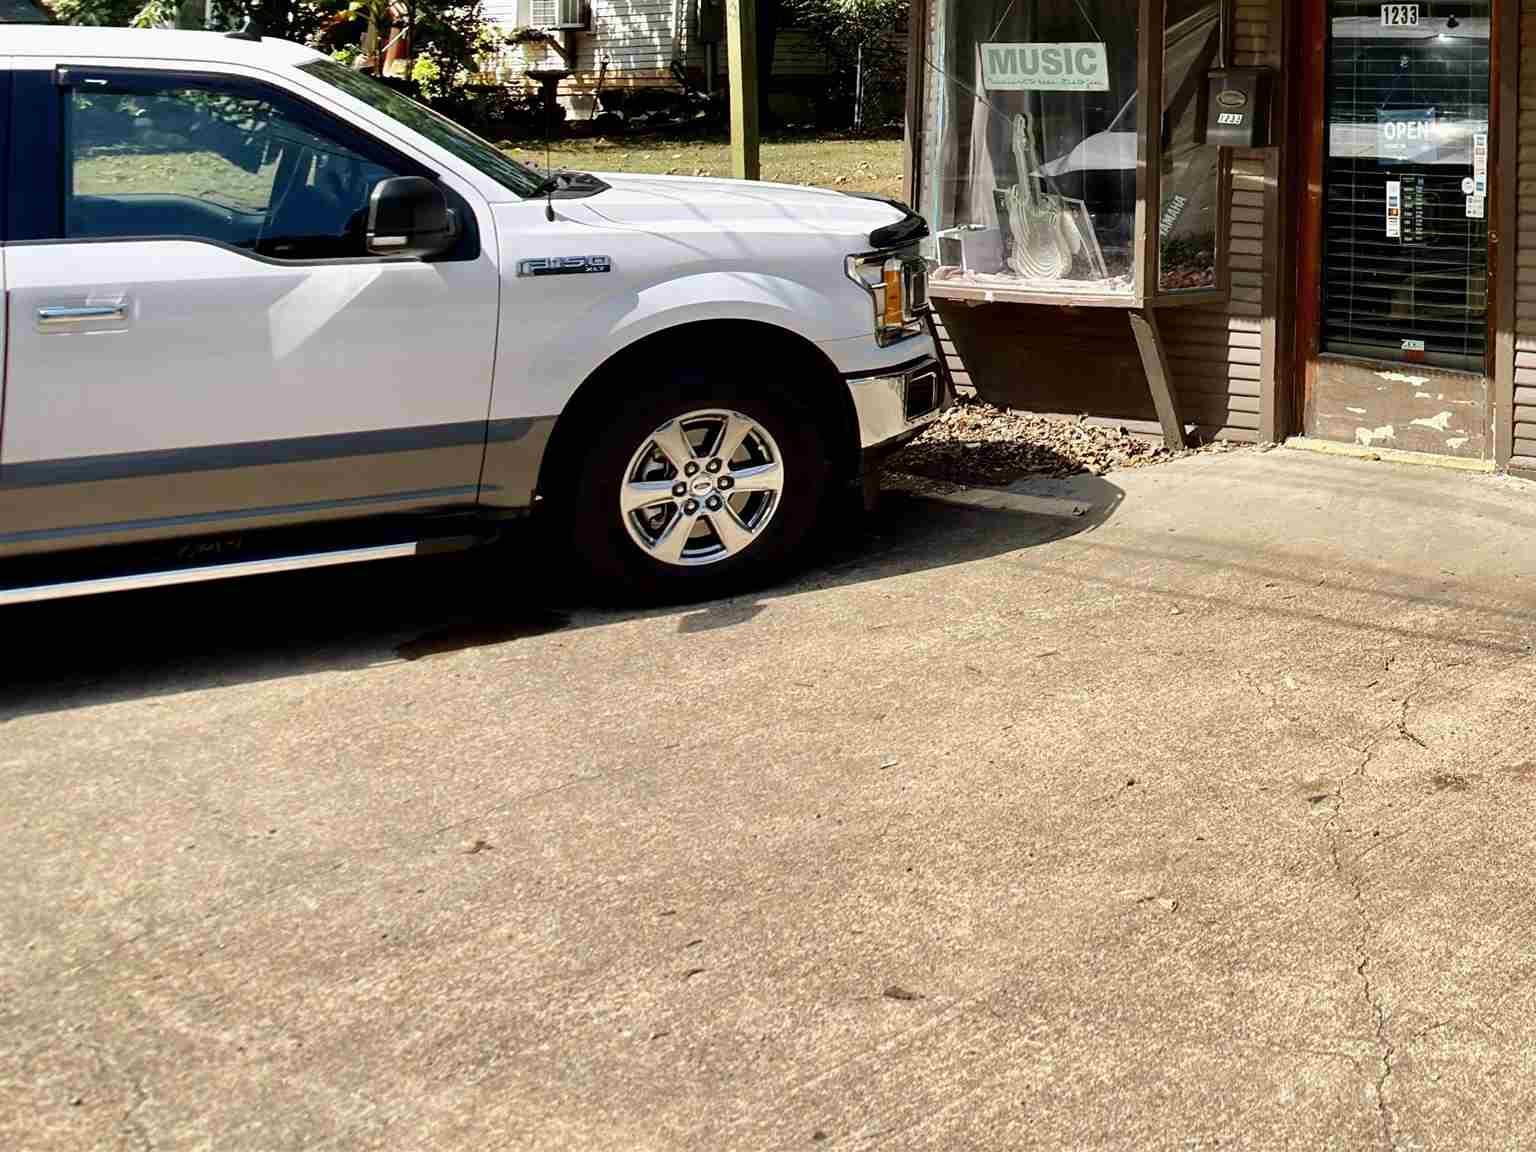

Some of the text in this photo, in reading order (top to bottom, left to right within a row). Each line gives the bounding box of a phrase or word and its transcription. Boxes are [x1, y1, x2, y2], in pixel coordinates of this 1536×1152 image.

[1382, 6, 1418, 25] 1233
[987, 47, 1097, 75] MUSIC
[1383, 121, 1429, 139] OPEN
